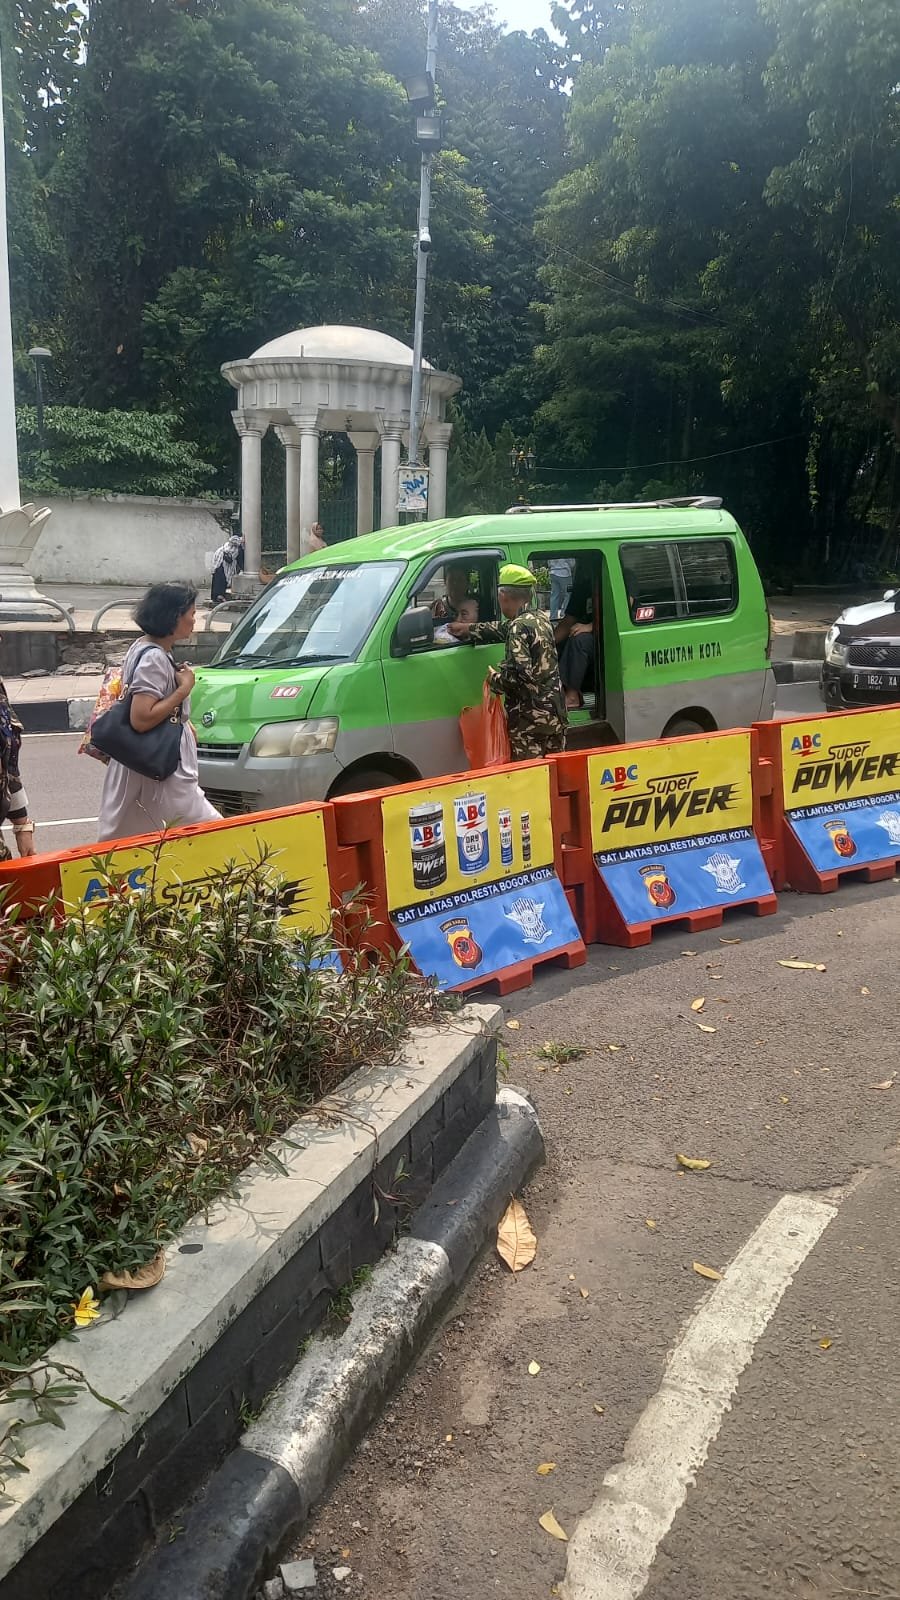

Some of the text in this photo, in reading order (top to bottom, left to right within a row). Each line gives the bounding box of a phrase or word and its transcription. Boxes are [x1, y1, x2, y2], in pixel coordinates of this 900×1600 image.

[638, 608, 654, 619] 10
[644, 641, 722, 668] ANGKUTAN KOTA
[867, 675, 883, 685] 1824
[888, 676, 897, 686] XA
[275, 687, 299, 697] 10
[791, 733, 822, 751] ABC
[828, 741, 871, 762] Super
[601, 764, 638, 785] ABC
[646, 771, 699, 795] Super
[792, 752, 900, 794] POWER
[457, 802, 486, 822] ABC
[602, 782, 742, 833] POWER
[791, 810, 806, 820] SAT
[806, 806, 834, 818] LANTAS
[834, 799, 869, 812] POLRESTA
[870, 794, 896, 805] BOGOR
[413, 823, 442, 842] ABC
[465, 835, 480, 844] DRY
[465, 844, 481, 854] CELL
[600, 829, 751, 864] SAT LANTAS POLRESTA BOGOR KOTA
[413, 856, 445, 875] POWER
[397, 868, 552, 924] SAT LANTAS POLRESTA BOGOR KOTA
